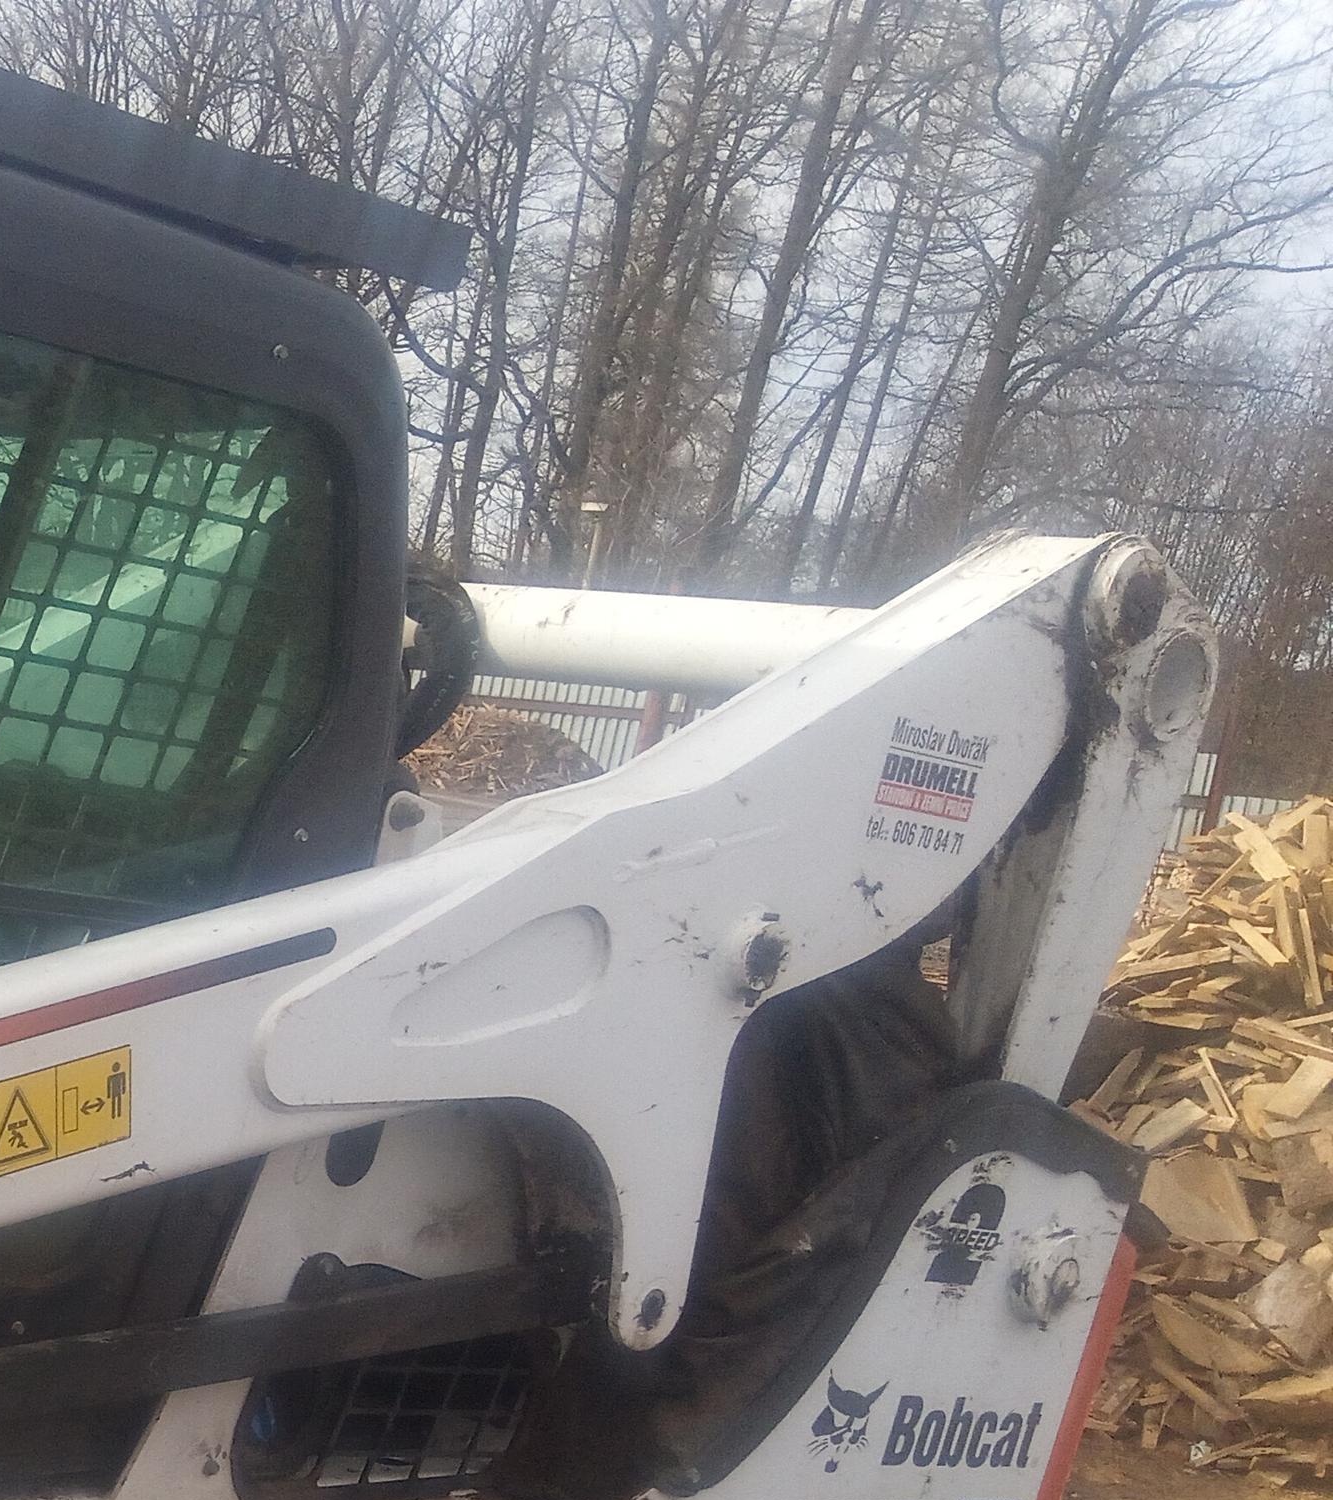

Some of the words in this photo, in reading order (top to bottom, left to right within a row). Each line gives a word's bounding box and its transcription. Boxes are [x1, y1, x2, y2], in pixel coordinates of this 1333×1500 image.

[891, 717, 946, 753] Miroslav
[947, 730, 990, 763] Dvořák
[881, 752, 979, 799] DRUMELL
[892, 819, 916, 846] 606
[918, 825, 933, 849] 70
[933, 829, 950, 852] 84
[951, 832, 965, 855] 71
[881, 1395, 1043, 1469] Bobcat
